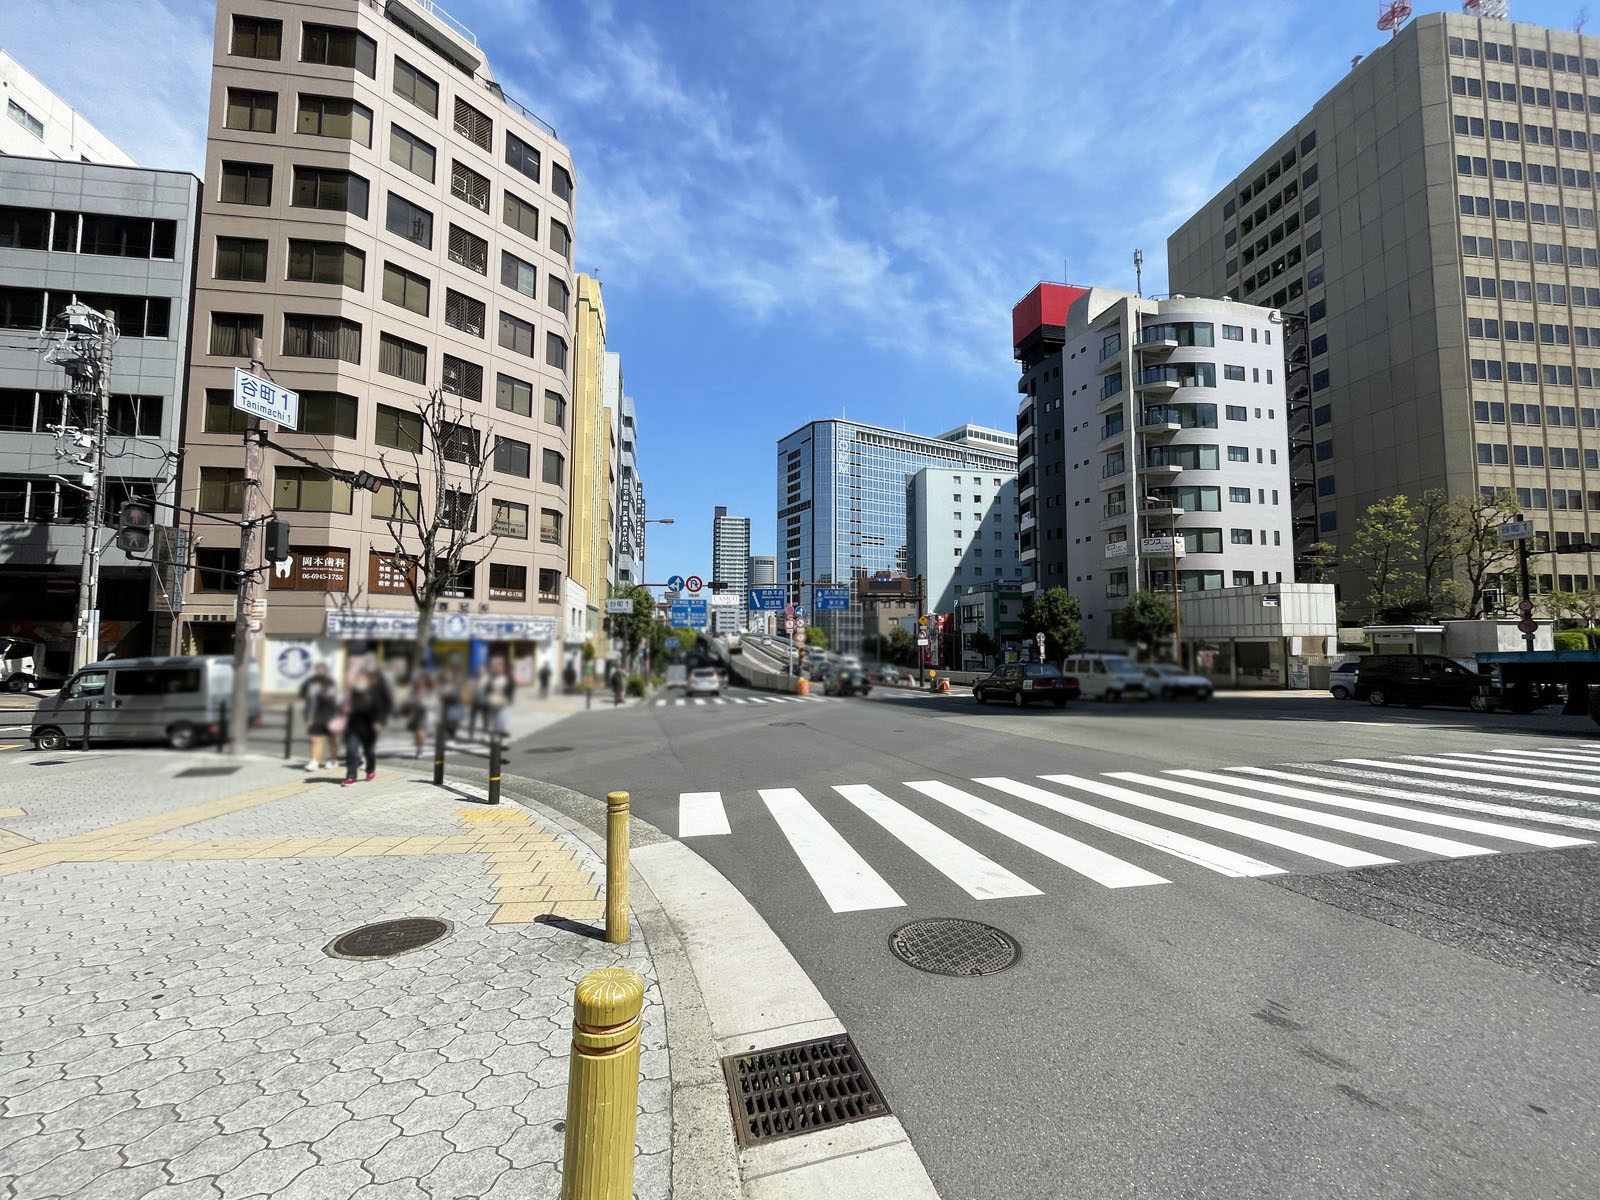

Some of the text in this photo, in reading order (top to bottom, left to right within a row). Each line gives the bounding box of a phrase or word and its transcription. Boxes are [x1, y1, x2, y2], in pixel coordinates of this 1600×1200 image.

[241, 378, 288, 411] 谷町 1
[241, 395, 291, 423] Tanimachi 1
[302, 556, 346, 568] 岡本歯科
[301, 573, 344, 581] 06-6945-1755
